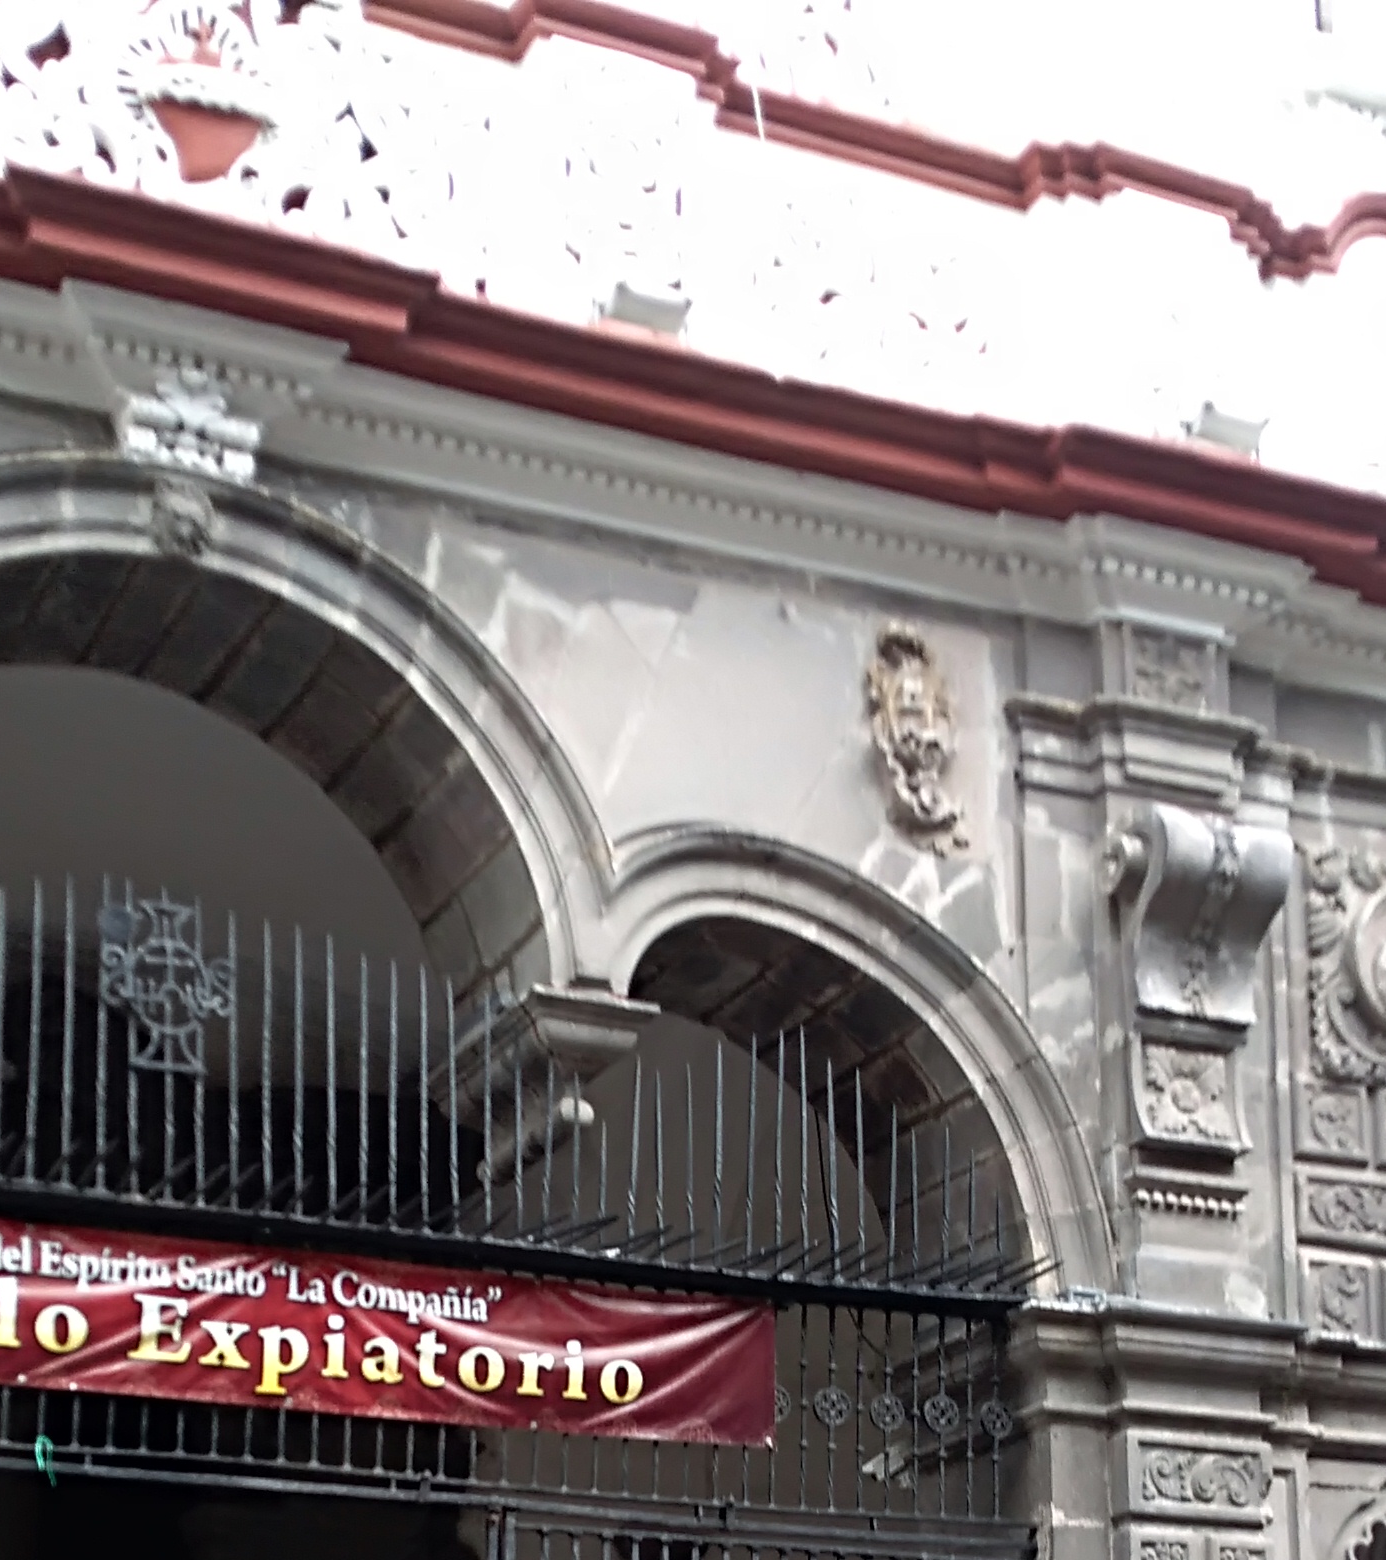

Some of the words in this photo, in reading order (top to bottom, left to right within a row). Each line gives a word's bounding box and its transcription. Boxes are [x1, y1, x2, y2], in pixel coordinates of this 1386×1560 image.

[39, 1239, 173, 1294] Espíritu
[176, 1253, 266, 1298] Santo
[128, 1292, 644, 1405] Expiatorio
